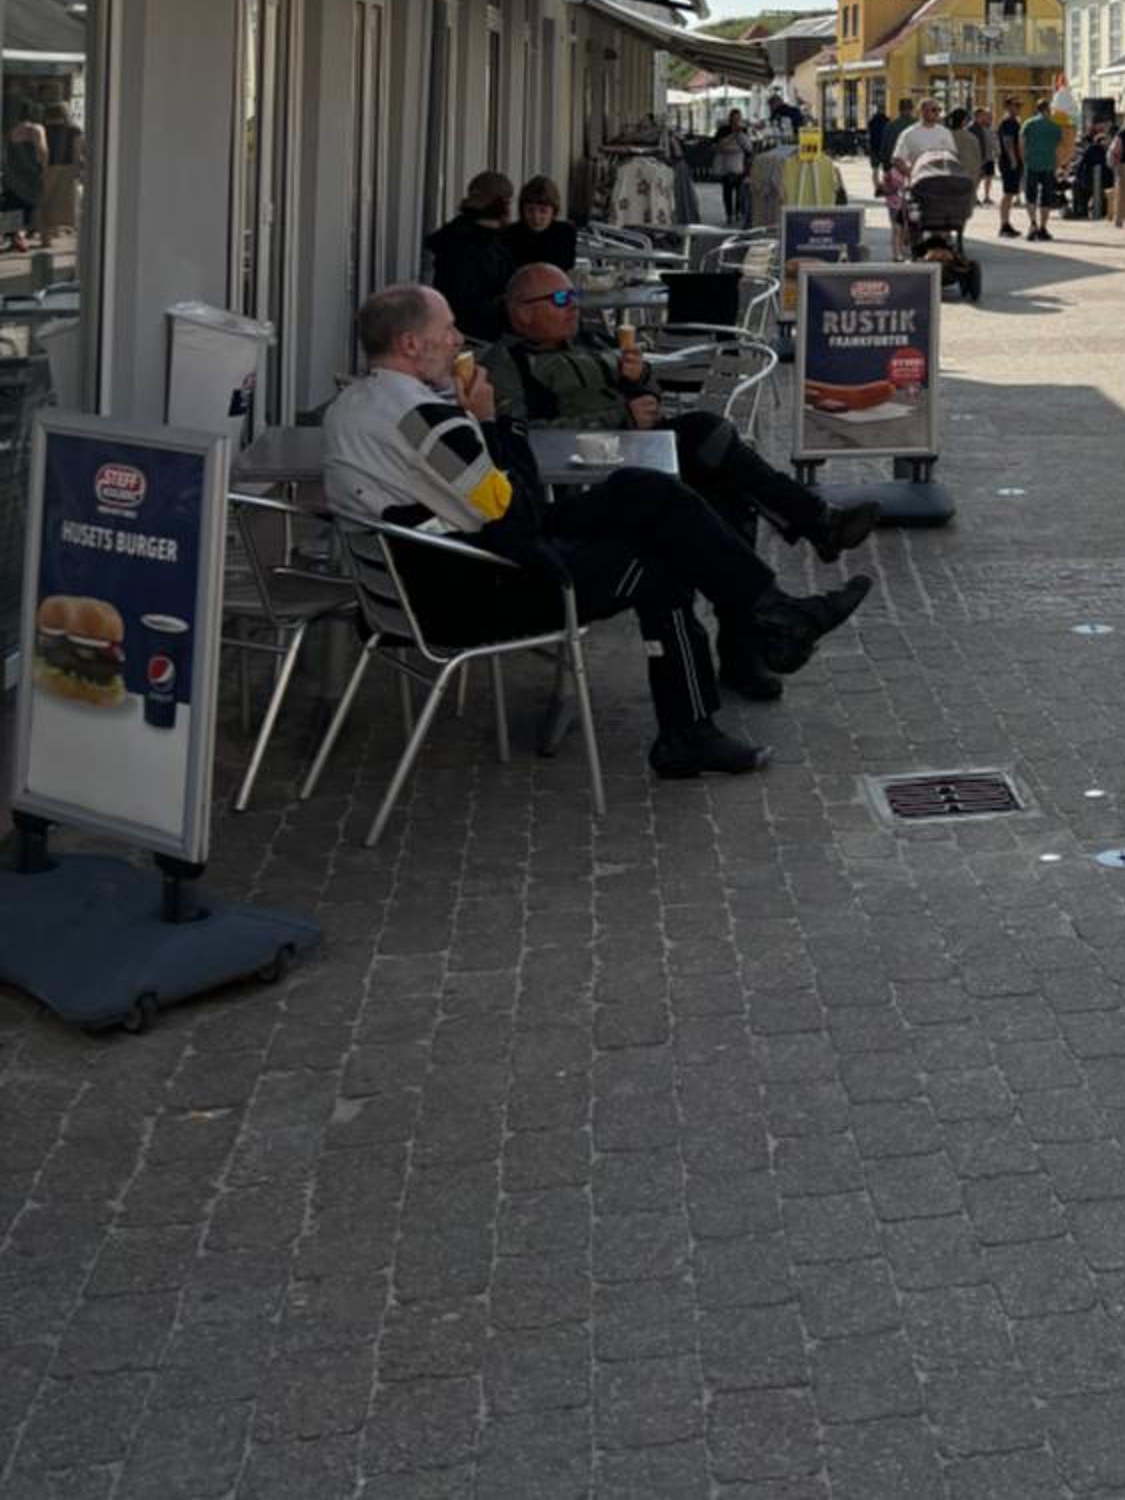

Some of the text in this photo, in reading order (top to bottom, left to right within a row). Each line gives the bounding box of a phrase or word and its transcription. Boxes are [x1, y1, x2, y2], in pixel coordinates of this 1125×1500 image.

[822, 308, 916, 334] RUSTIK
[61, 519, 178, 562] HUSETS BURGER
